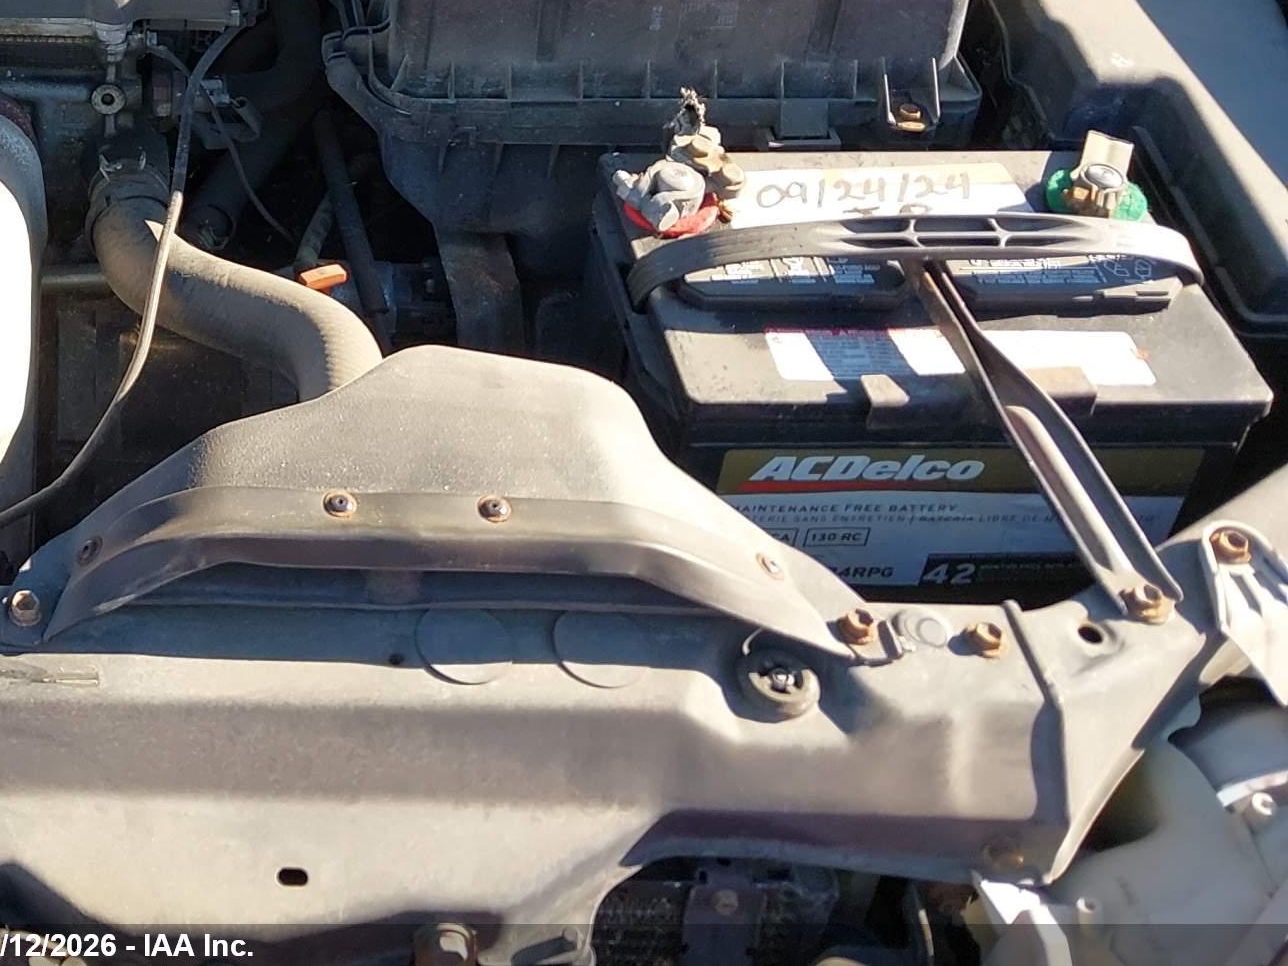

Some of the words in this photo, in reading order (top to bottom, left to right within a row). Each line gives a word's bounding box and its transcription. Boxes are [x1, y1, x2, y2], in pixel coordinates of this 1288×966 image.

[749, 454, 984, 482] ACDelco
[844, 504, 882, 512] FREE
[888, 504, 959, 512] BATTERY
[810, 532, 836, 542] 130
[841, 532, 862, 542] RC
[922, 562, 976, 585] 42
